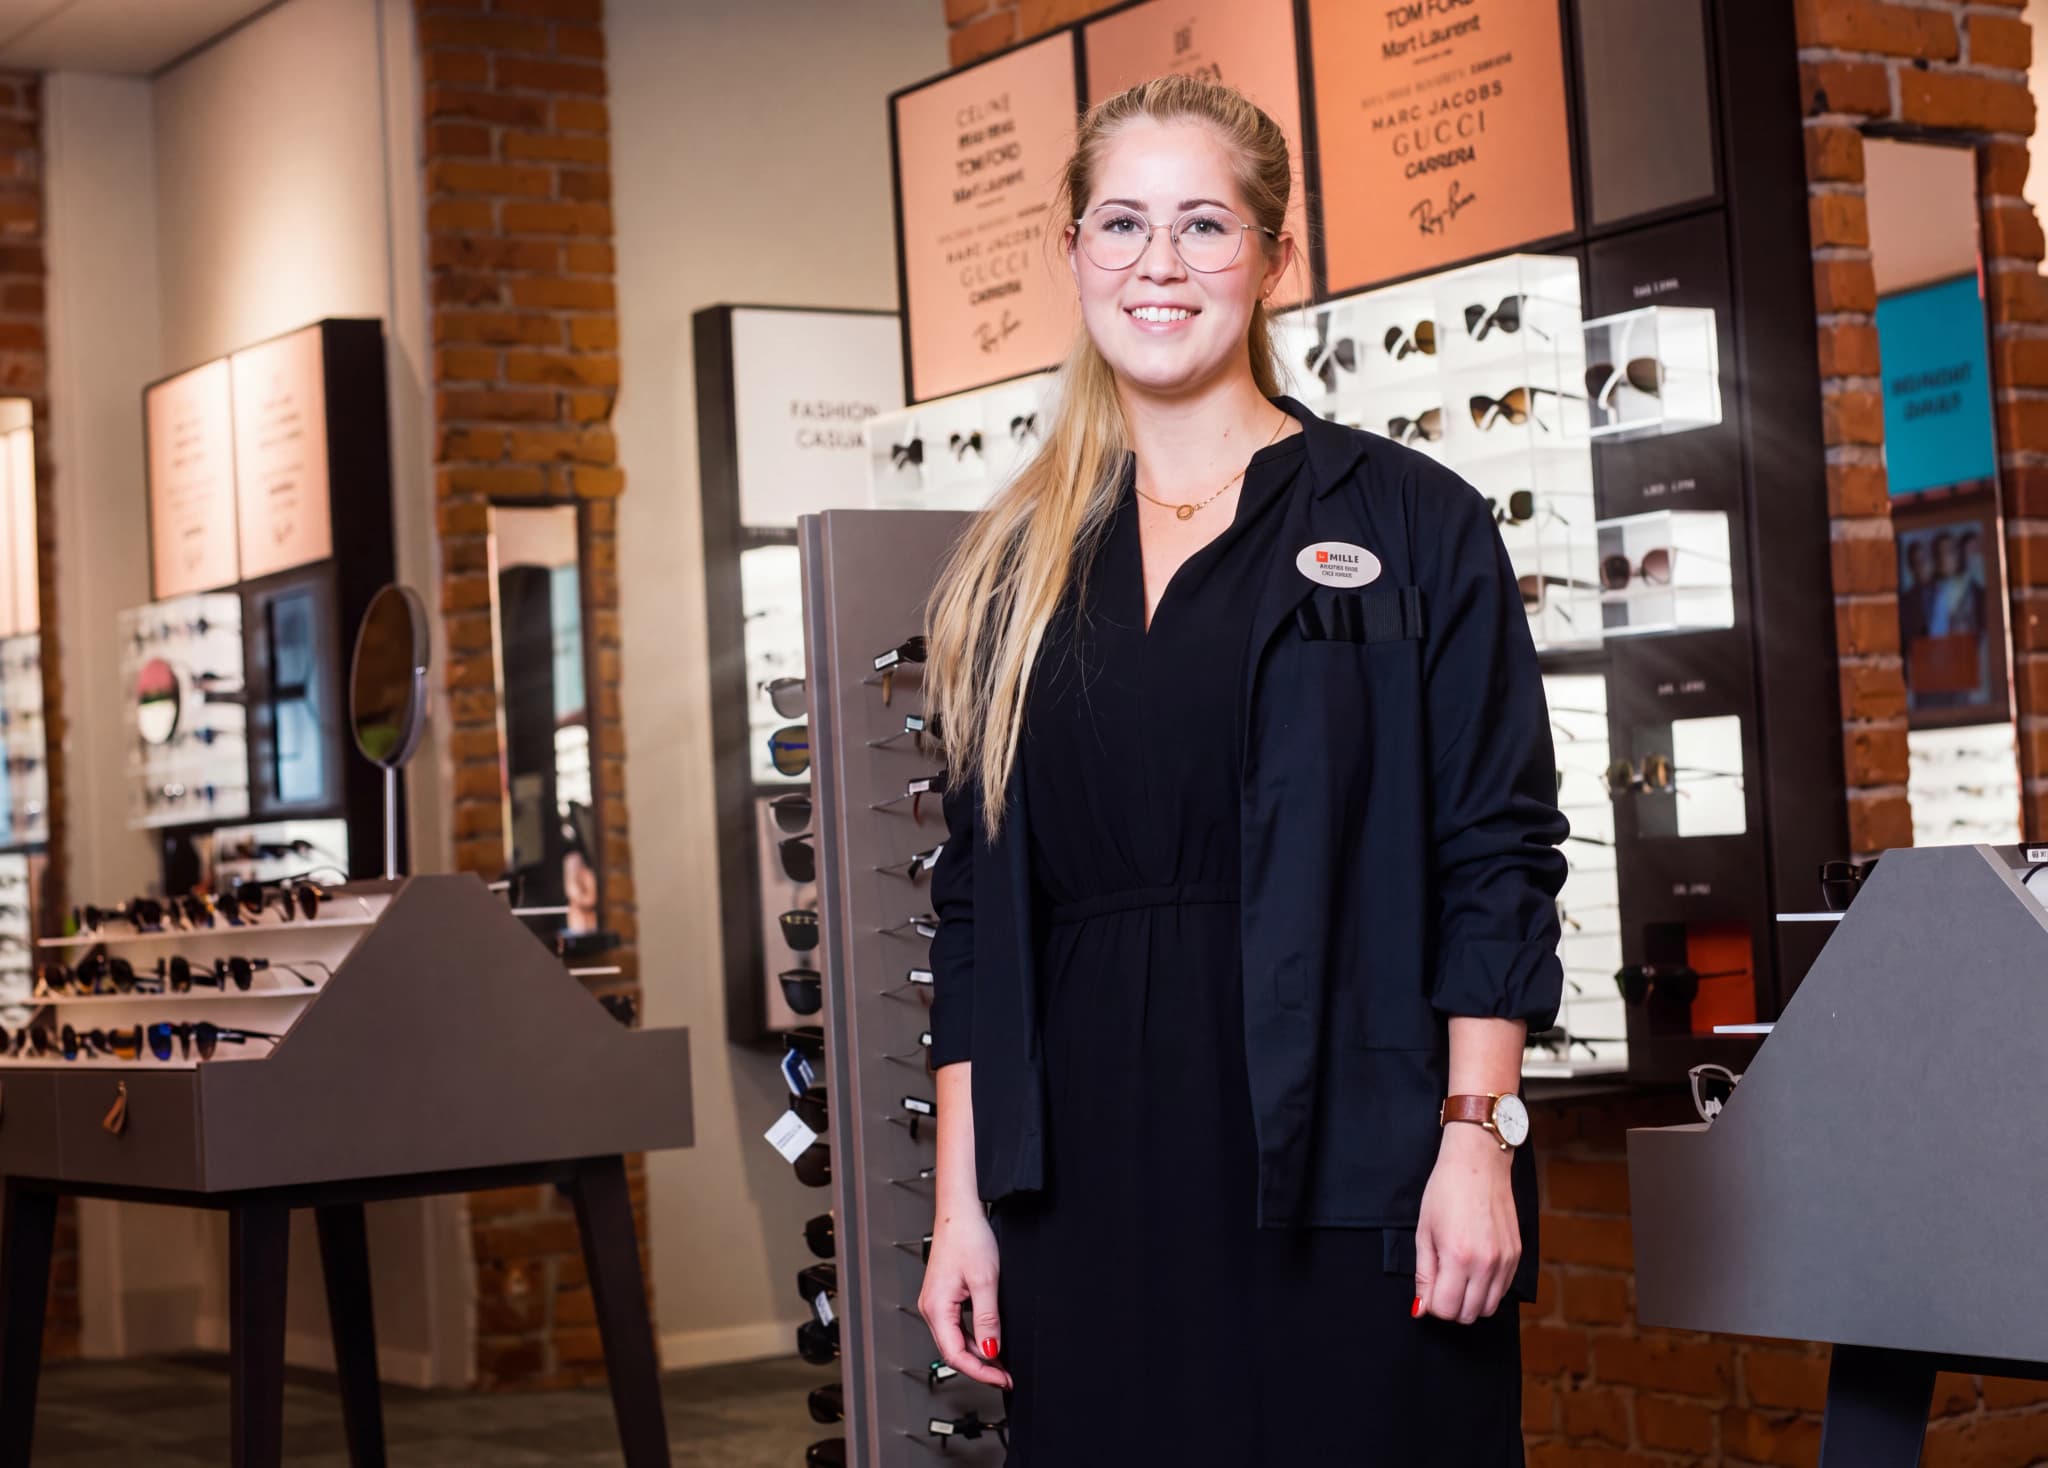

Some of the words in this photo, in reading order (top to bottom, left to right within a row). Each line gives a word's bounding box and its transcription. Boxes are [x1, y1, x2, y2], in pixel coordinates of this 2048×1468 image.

[1386, 1, 1422, 30] TOM
[1428, 0, 1474, 17] FO
[1420, 14, 1480, 48] Laurent
[1372, 105, 1421, 131] MARC
[1429, 80, 1503, 115] JACOBS
[1393, 109, 1485, 156] GUCCI
[1405, 145, 1476, 179] CARRERA
[959, 250, 1029, 288] GUCCI
[789, 400, 879, 421] FASHION
[795, 428, 864, 449] CASUA
[1330, 553, 1359, 564] MILLE
